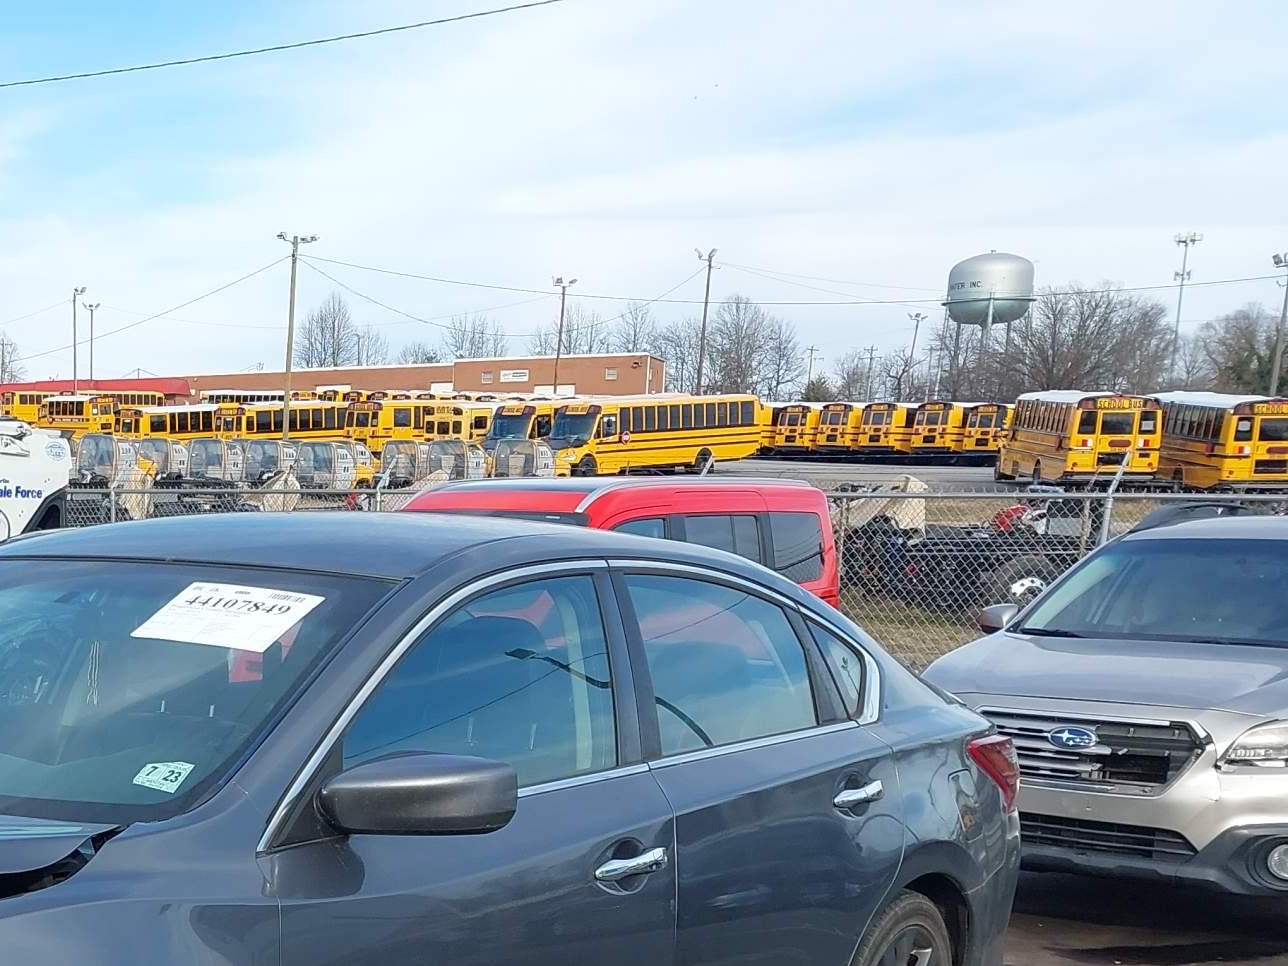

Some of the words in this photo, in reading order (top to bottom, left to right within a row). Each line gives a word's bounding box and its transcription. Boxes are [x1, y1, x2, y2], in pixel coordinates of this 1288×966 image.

[969, 281, 983, 289] INC.
[1099, 400, 1128, 408] SCHOOL
[15, 486, 42, 498] Force
[186, 595, 292, 615] 44107849
[145, 766, 159, 777] 7
[162, 770, 181, 783] 23
